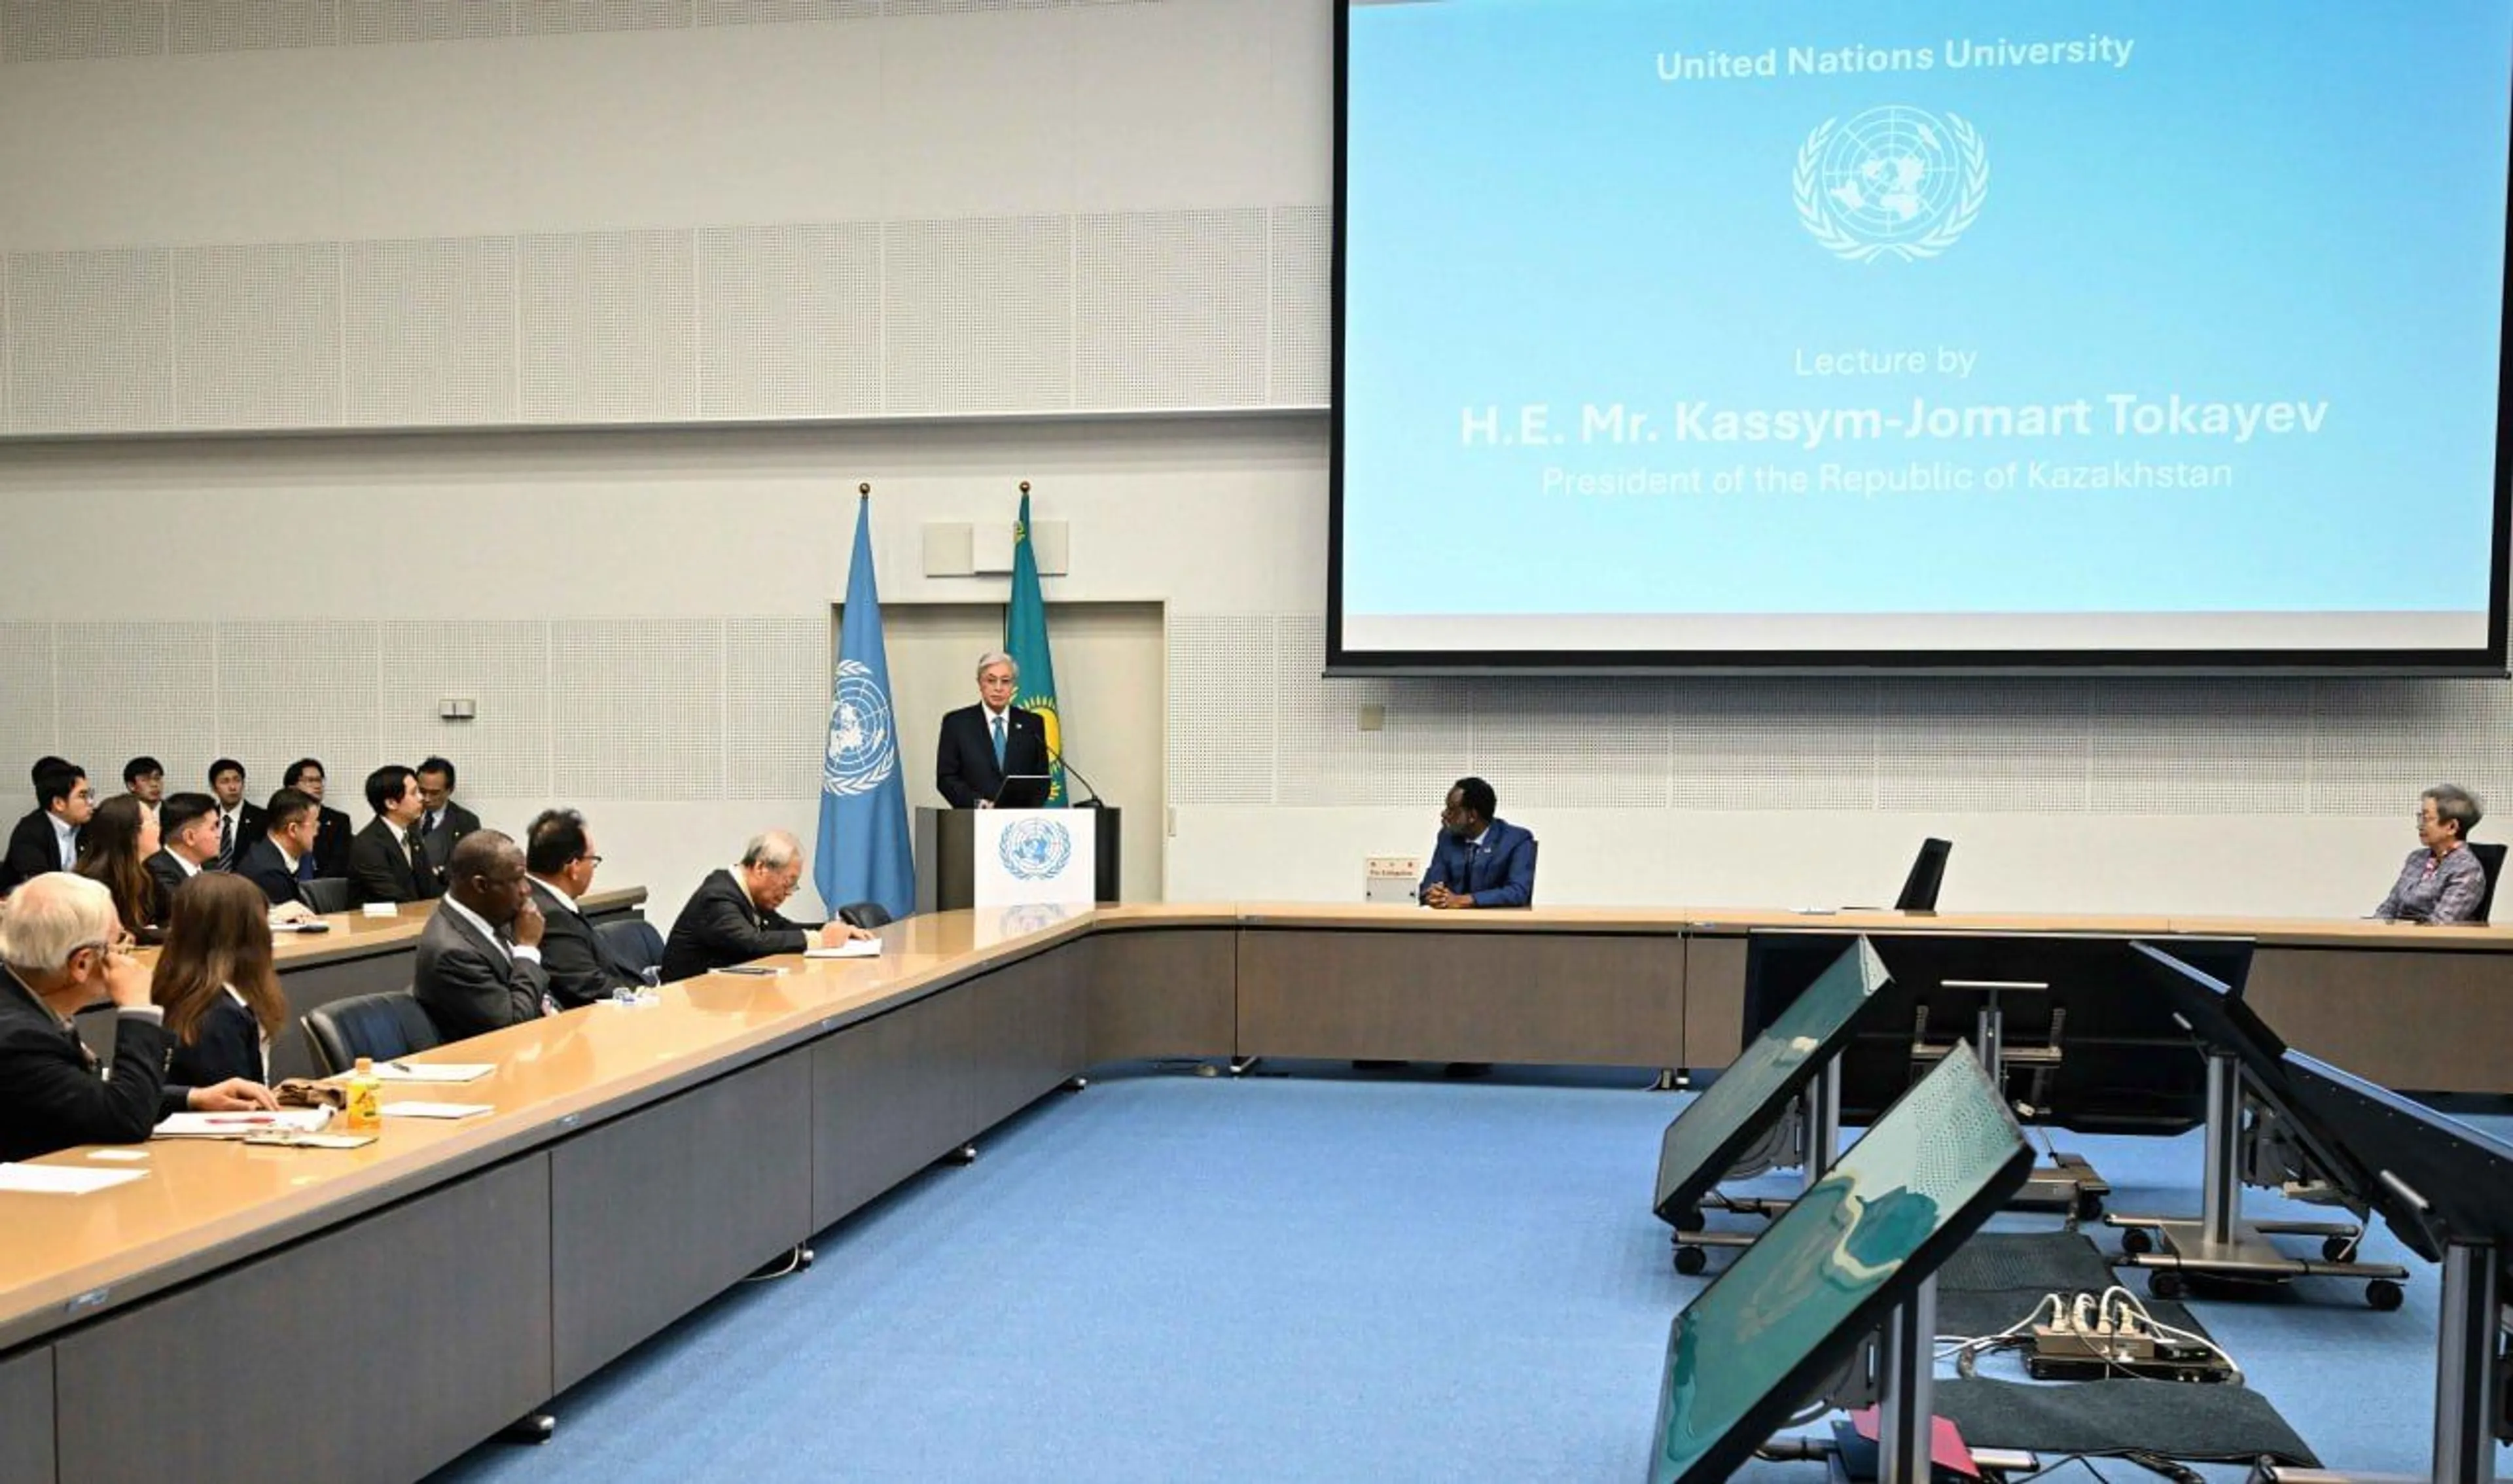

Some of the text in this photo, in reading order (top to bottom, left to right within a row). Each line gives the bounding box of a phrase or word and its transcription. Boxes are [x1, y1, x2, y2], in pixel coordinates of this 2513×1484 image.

[1656, 33, 2134, 81] United Nations University
[1795, 344, 1977, 380] Lecture by
[1460, 393, 2329, 449] H.E. Mr. Kassym-Jomart Tokayev
[1541, 459, 2233, 499] President of the Republic of Kazakhstan
